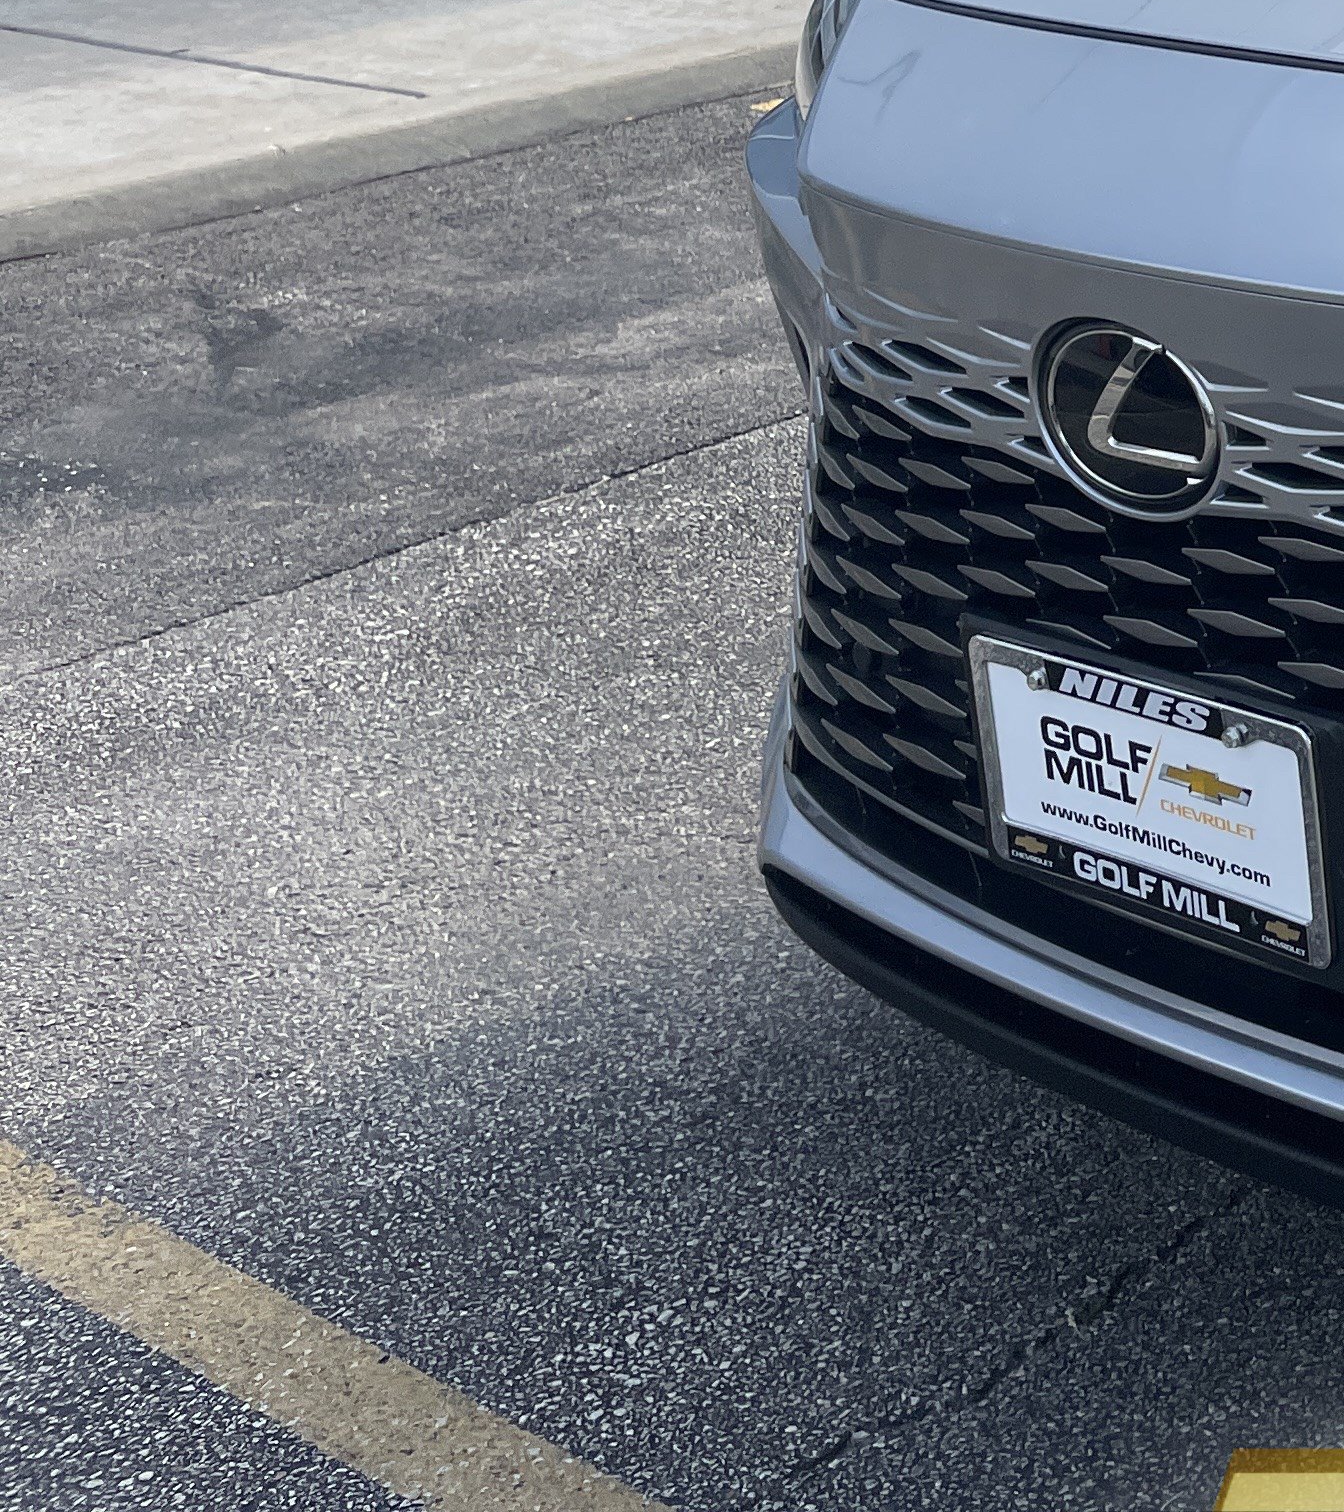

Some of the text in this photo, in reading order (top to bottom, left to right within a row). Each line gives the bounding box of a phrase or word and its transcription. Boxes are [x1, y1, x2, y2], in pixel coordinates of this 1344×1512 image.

[1059, 667, 1210, 732] NILES
[1040, 715, 1152, 774] GOLF
[1043, 747, 1138, 806] MILL
[1041, 800, 1271, 887] www.GolfMillChevy.com
[1159, 798, 1256, 841] CHEVROLET
[1073, 851, 1240, 933] GOLF MILL
